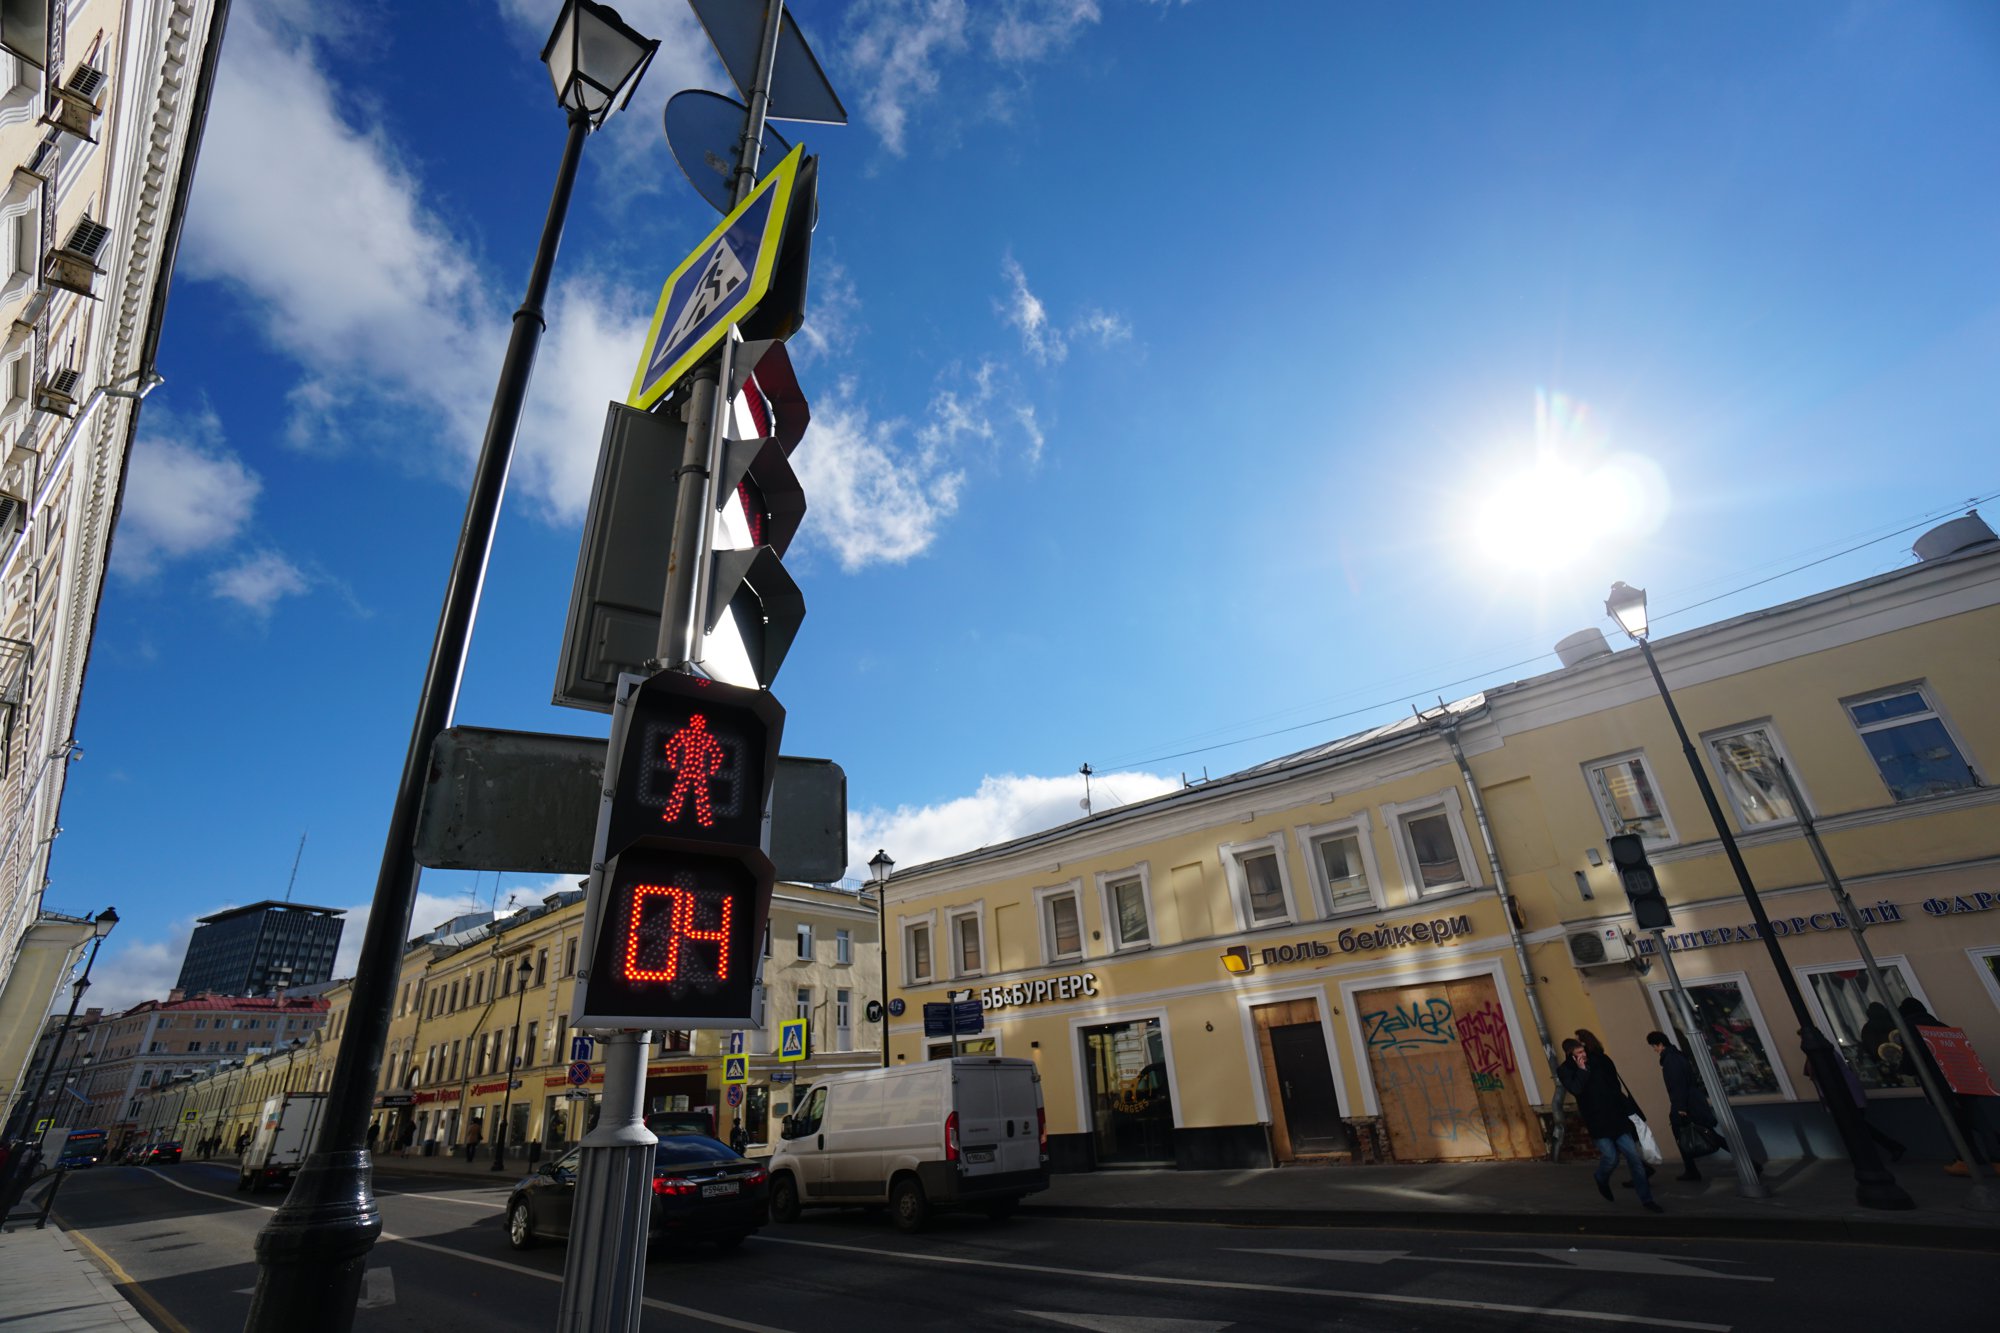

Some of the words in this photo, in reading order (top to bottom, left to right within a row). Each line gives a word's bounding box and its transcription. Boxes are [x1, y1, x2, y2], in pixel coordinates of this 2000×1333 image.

[624, 884, 733, 981] 04
[1261, 940, 1329, 965] поль
[1337, 914, 1471, 953] бейкери
[981, 973, 1096, 1010] ББ&БУРГЕРС
